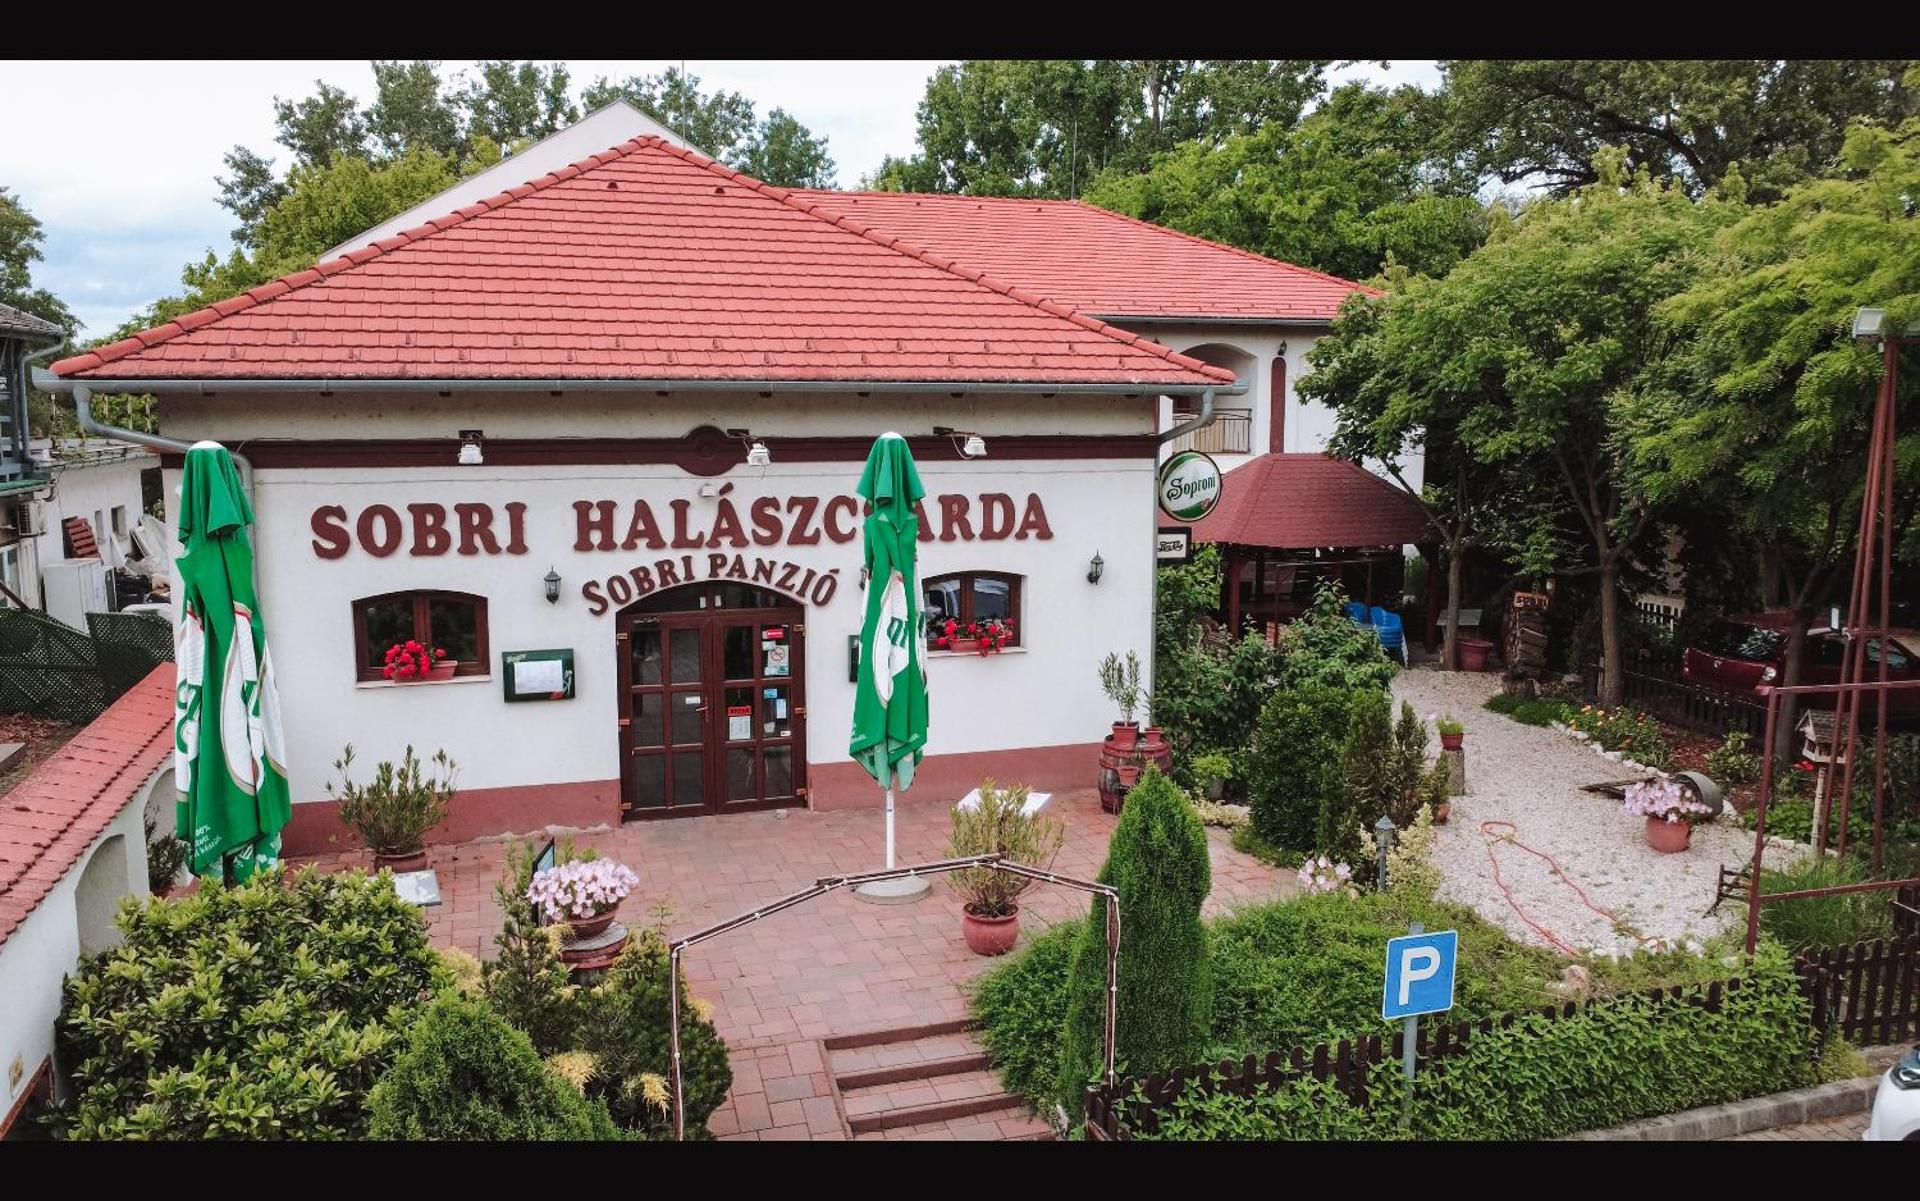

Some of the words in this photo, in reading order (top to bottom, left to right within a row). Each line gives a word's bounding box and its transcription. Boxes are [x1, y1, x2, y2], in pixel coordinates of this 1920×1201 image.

[1166, 475, 1216, 502] Soproni
[310, 501, 529, 560] SOBRI
[571, 481, 1054, 552] HALÁSZCRDA
[581, 554, 696, 616] SOBRI
[707, 552, 841, 607] PANZIÓ
[1398, 945, 1441, 1006] P
